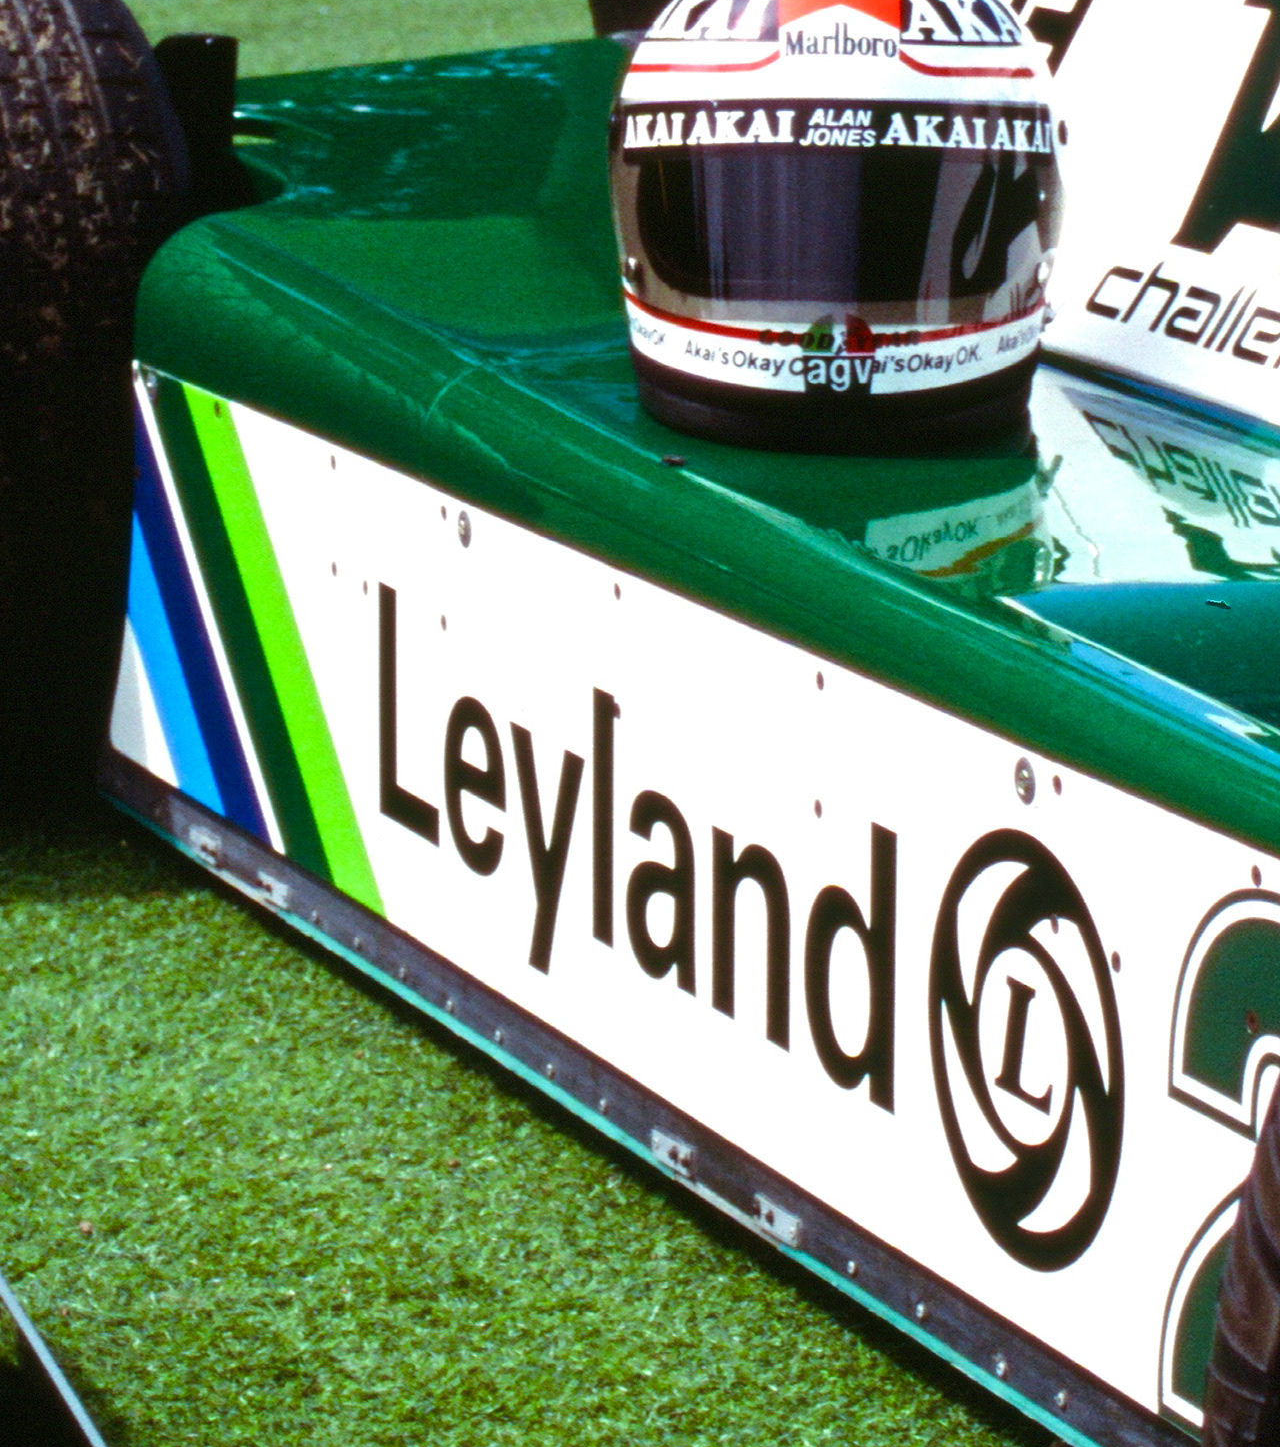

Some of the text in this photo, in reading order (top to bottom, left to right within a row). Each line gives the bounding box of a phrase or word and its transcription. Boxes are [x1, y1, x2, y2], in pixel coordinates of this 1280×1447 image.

[785, 22, 897, 58] Marlboro
[623, 108, 796, 149] AKAI AKAI
[808, 108, 873, 128] ALAN
[880, 112, 1052, 154] AKAI AKAI
[799, 128, 877, 147] JONES
[732, 350, 787, 377] Okay
[807, 358, 872, 391] agv
[906, 353, 953, 374] Okay
[377, 581, 898, 1115] Leyland
